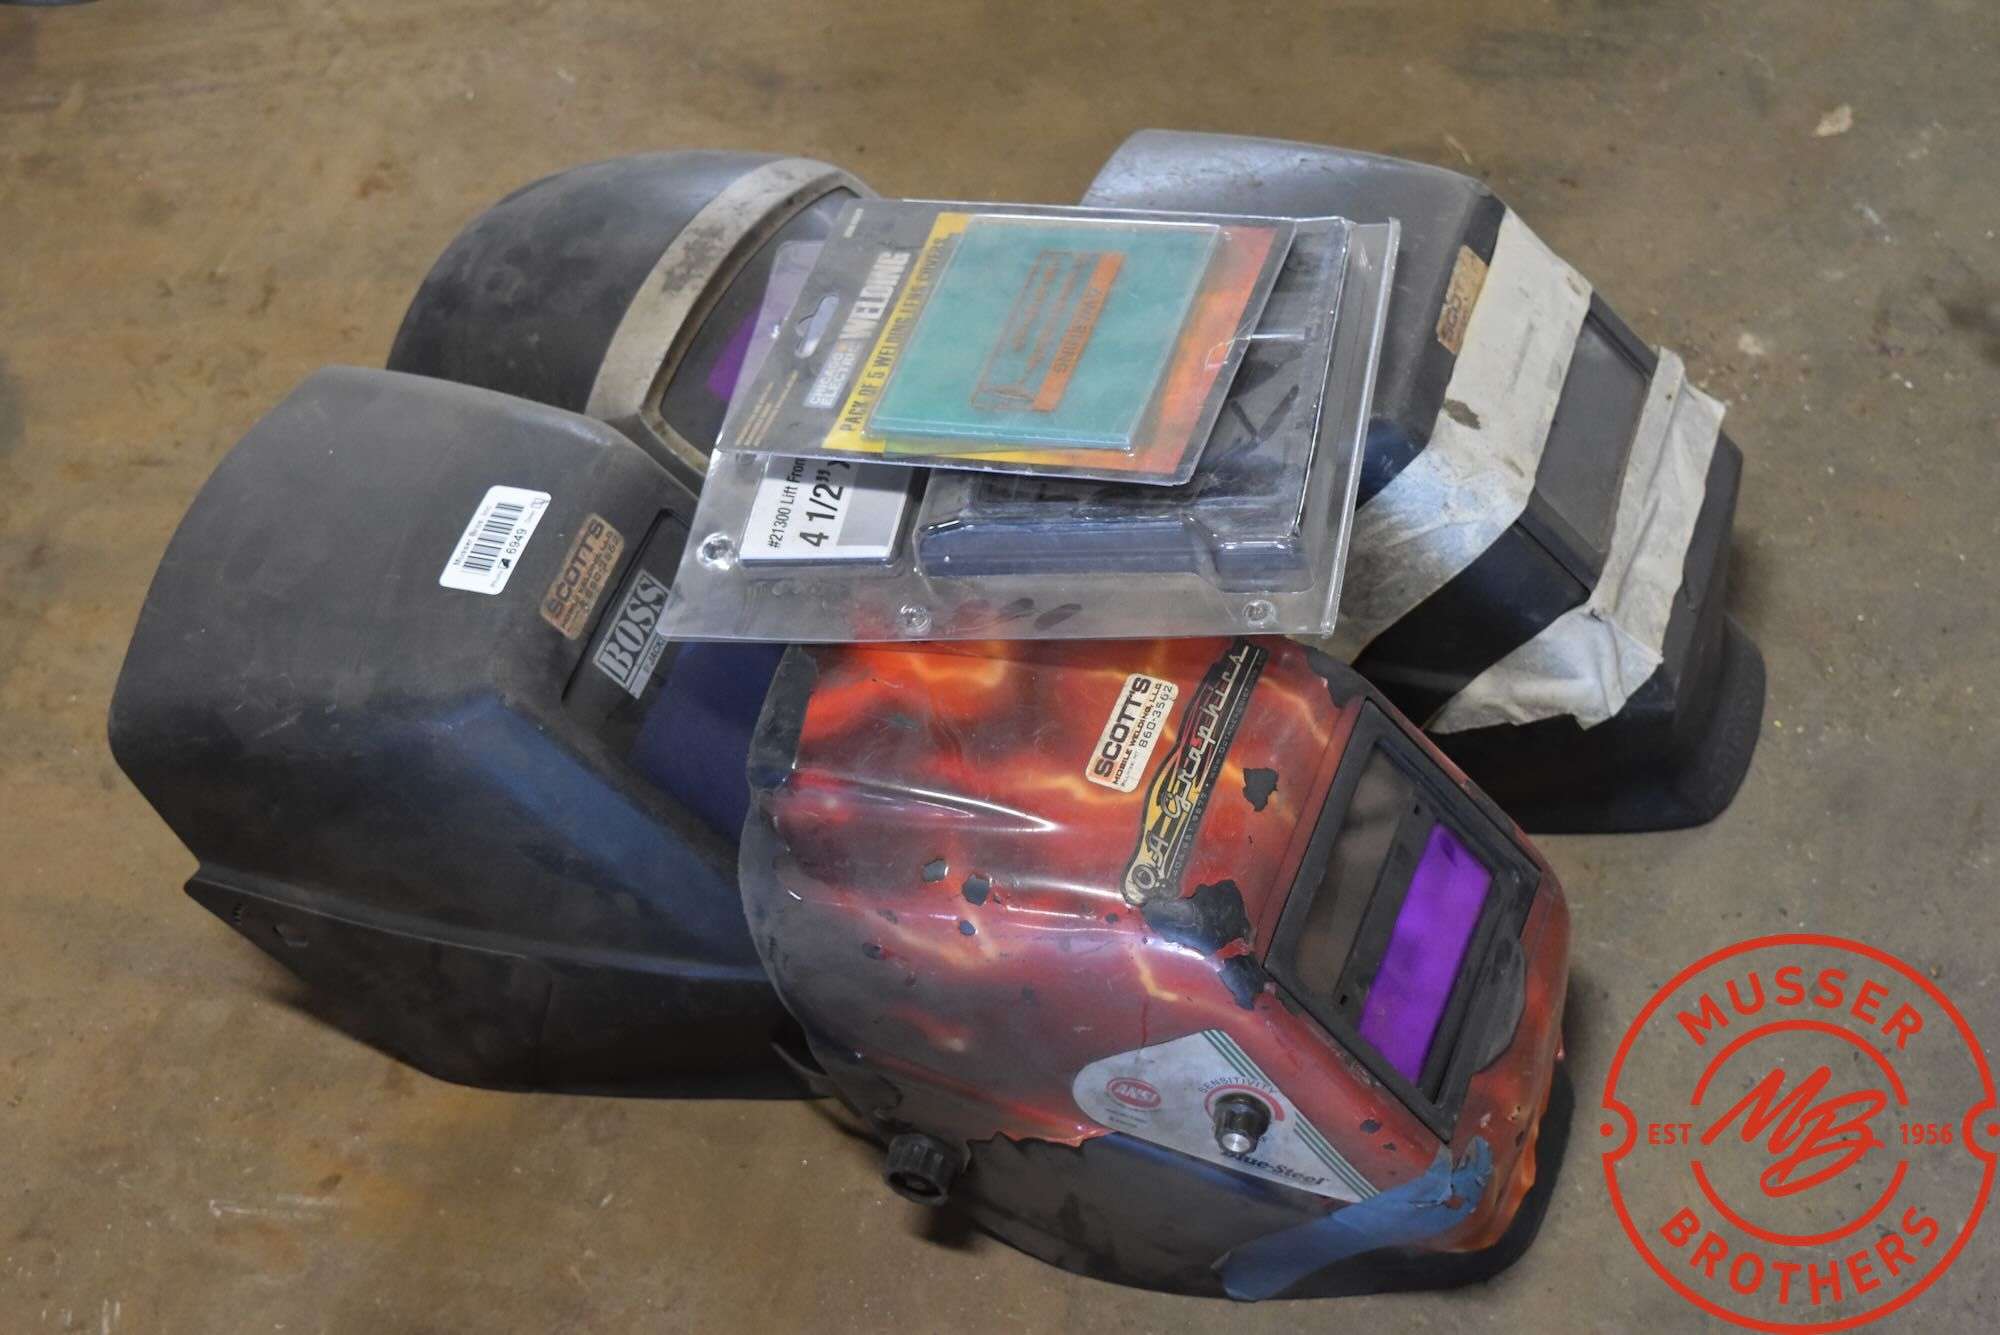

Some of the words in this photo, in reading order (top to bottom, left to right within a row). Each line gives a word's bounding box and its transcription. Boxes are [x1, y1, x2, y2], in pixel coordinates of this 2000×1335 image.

[838, 251, 911, 339] WELDING
[873, 317, 907, 367] WELDING
[867, 371, 885, 379] 5
[858, 383, 876, 398] OF
[840, 401, 864, 432] PACK
[787, 458, 806, 483] Fron
[783, 482, 798, 505] Lift
[506, 527, 527, 554] 6949
[768, 508, 791, 549] #21300
[799, 531, 829, 548] 4
[601, 577, 666, 681] BOSS
[1094, 677, 1151, 777] SCOTT'S
[1113, 750, 1132, 784] MOBILE
[1199, 1075, 1278, 1095] SENSITIVITY
